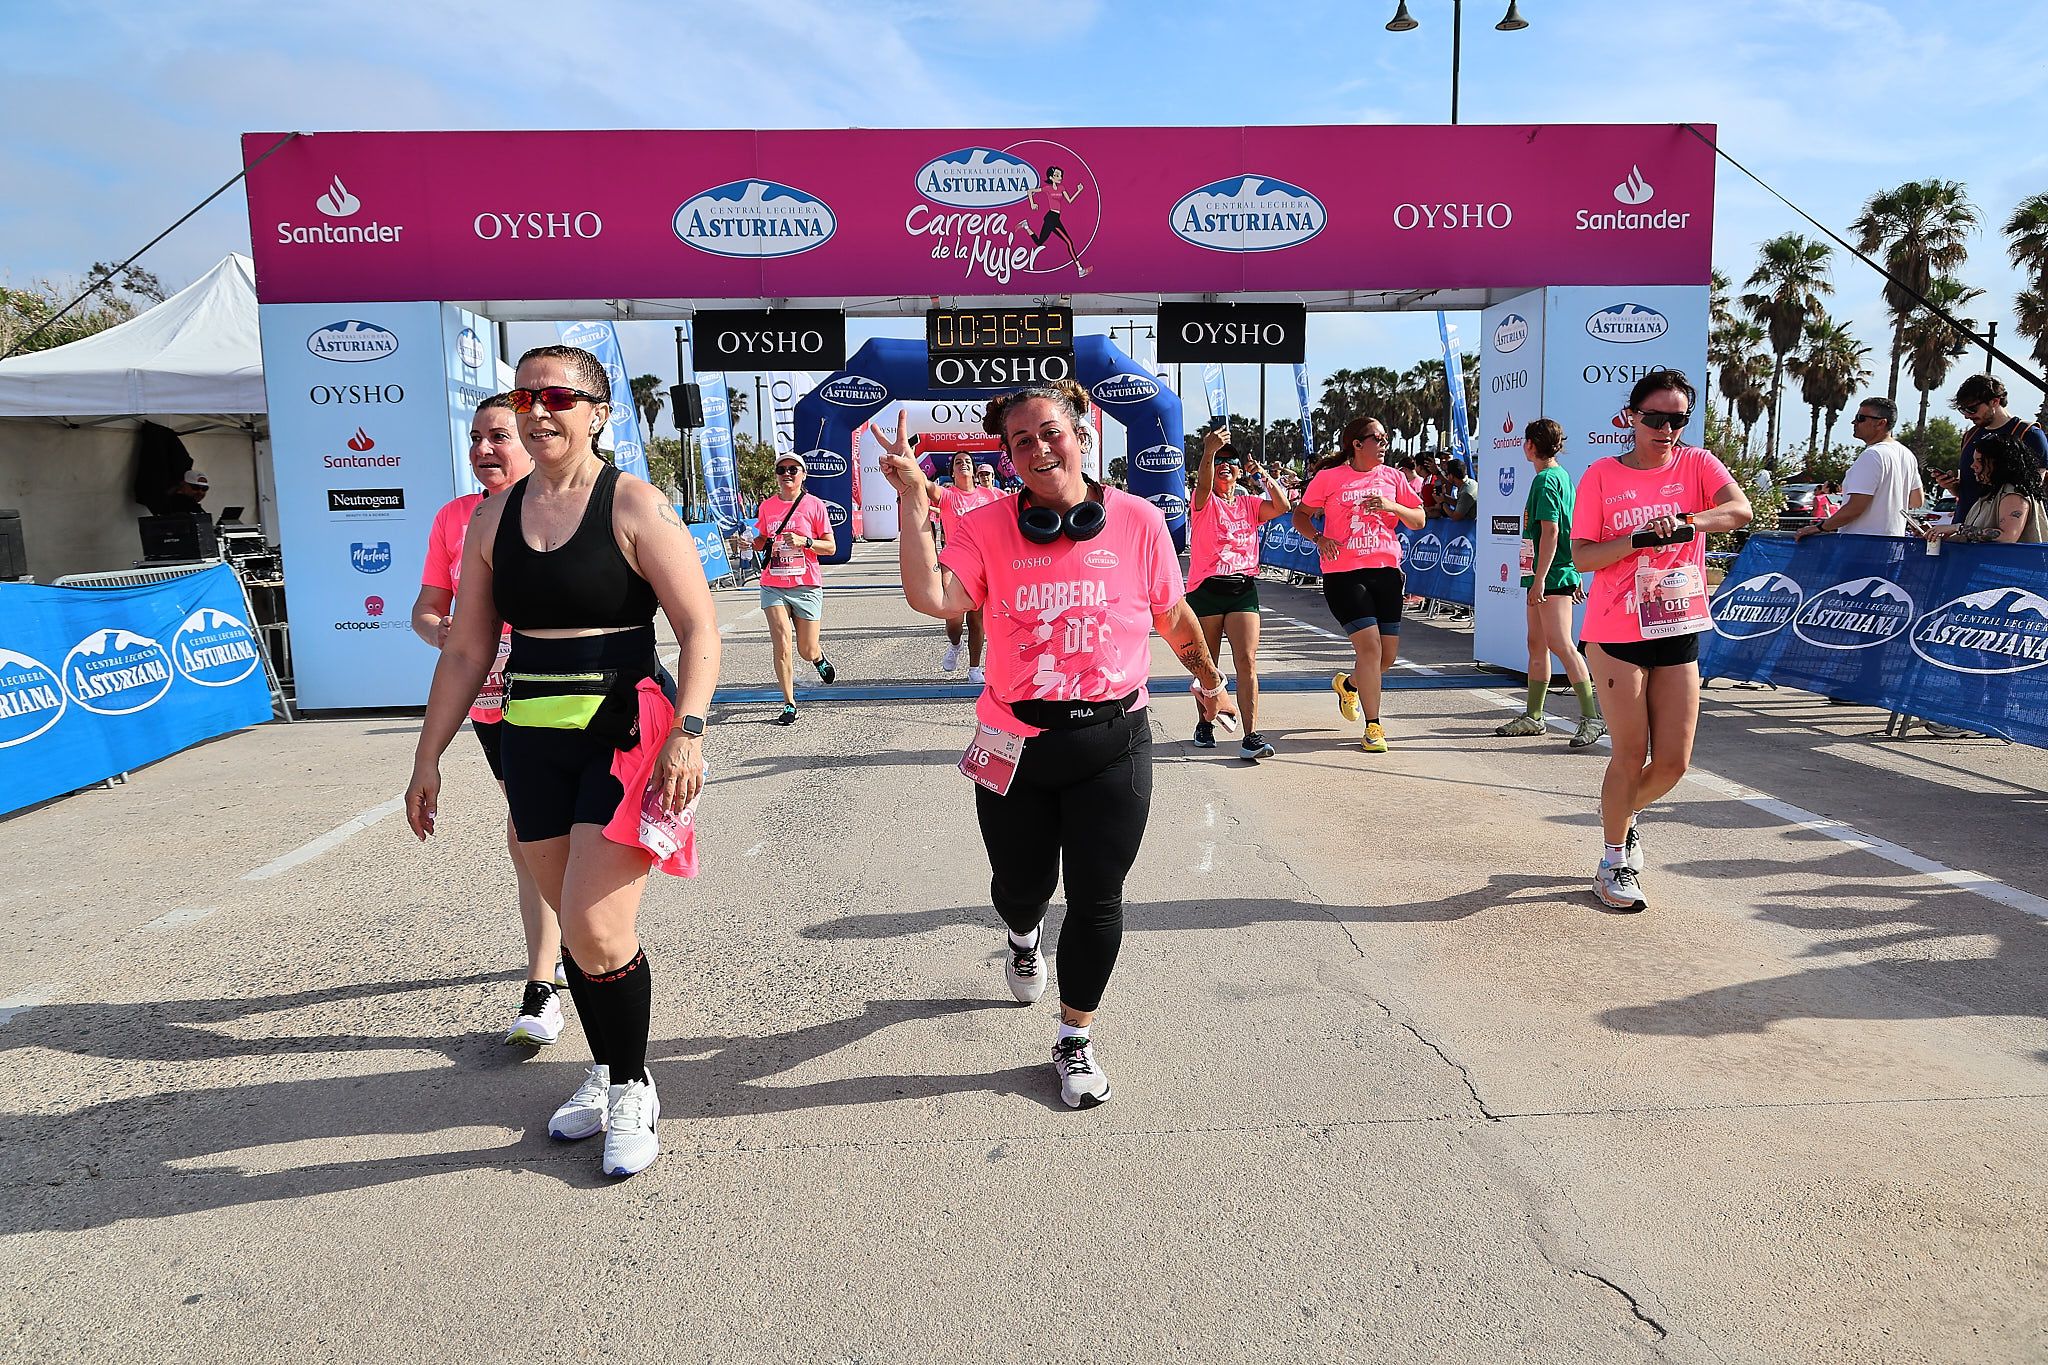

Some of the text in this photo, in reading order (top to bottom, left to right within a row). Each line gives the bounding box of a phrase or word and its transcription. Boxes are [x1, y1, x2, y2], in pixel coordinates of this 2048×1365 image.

[925, 170, 1030, 192] ASTURIANA
[766, 206, 818, 214] LECHERA
[1182, 204, 1315, 232] ASTURIANA
[1393, 202, 1513, 230] OYSHO
[1575, 208, 1690, 230] Santander
[473, 211, 603, 240] OYSHO
[686, 208, 824, 237] ASTURIANA
[905, 204, 1008, 236] Carrera
[277, 222, 403, 245] Santander
[931, 232, 1046, 284] de la Mujer
[937, 314, 1063, 346] 00:36:52
[1181, 322, 1285, 345] OYSHO
[1592, 320, 1662, 334] ASTURIANA
[315, 337, 393, 352] ASTURIANA
[717, 331, 823, 353] OYSHO
[1495, 330, 1526, 347] ASTURIANA
[935, 356, 1069, 386] OYSHO
[1583, 365, 1666, 383] OYSH
[1098, 384, 1155, 398] ASTURIANA
[1492, 370, 1528, 394] OYSHO
[310, 384, 404, 405] OYSHO
[825, 387, 881, 400] ASTURIANA
[931, 404, 982, 423] OYS
[930, 433, 957, 442] Sports
[1493, 436, 1524, 450] Santander
[323, 454, 401, 468] Santander
[805, 462, 843, 471] STURIANA
[333, 493, 400, 509] Neutrogena
[353, 549, 390, 566] Marlene
[1012, 556, 1052, 570] OYSHO
[1015, 579, 1108, 612] CARRERA
[1664, 598, 1690, 611] 016
[1736, 594, 1765, 604] CENTRAL
[1717, 600, 1791, 624] ASTURIANA
[1827, 598, 1905, 614] CENTRAL LECHERA
[335, 621, 412, 631] octopus energ
[1799, 600, 1902, 636] ASTURIANA
[1955, 613, 2048, 631] CENTRAL LECHER
[189, 630, 246, 646] CENTRAL LECHERA
[1063, 617, 1097, 653] DE
[1650, 626, 1676, 635] OYSHO
[1917, 620, 2048, 661] ASTURIANA
[86, 657, 123, 672] CENTRAL
[181, 639, 256, 673] ASTURIANA
[74, 659, 168, 702] ASTURIANA
[0, 684, 61, 720] RIANA
[1070, 708, 1094, 719] FILA
